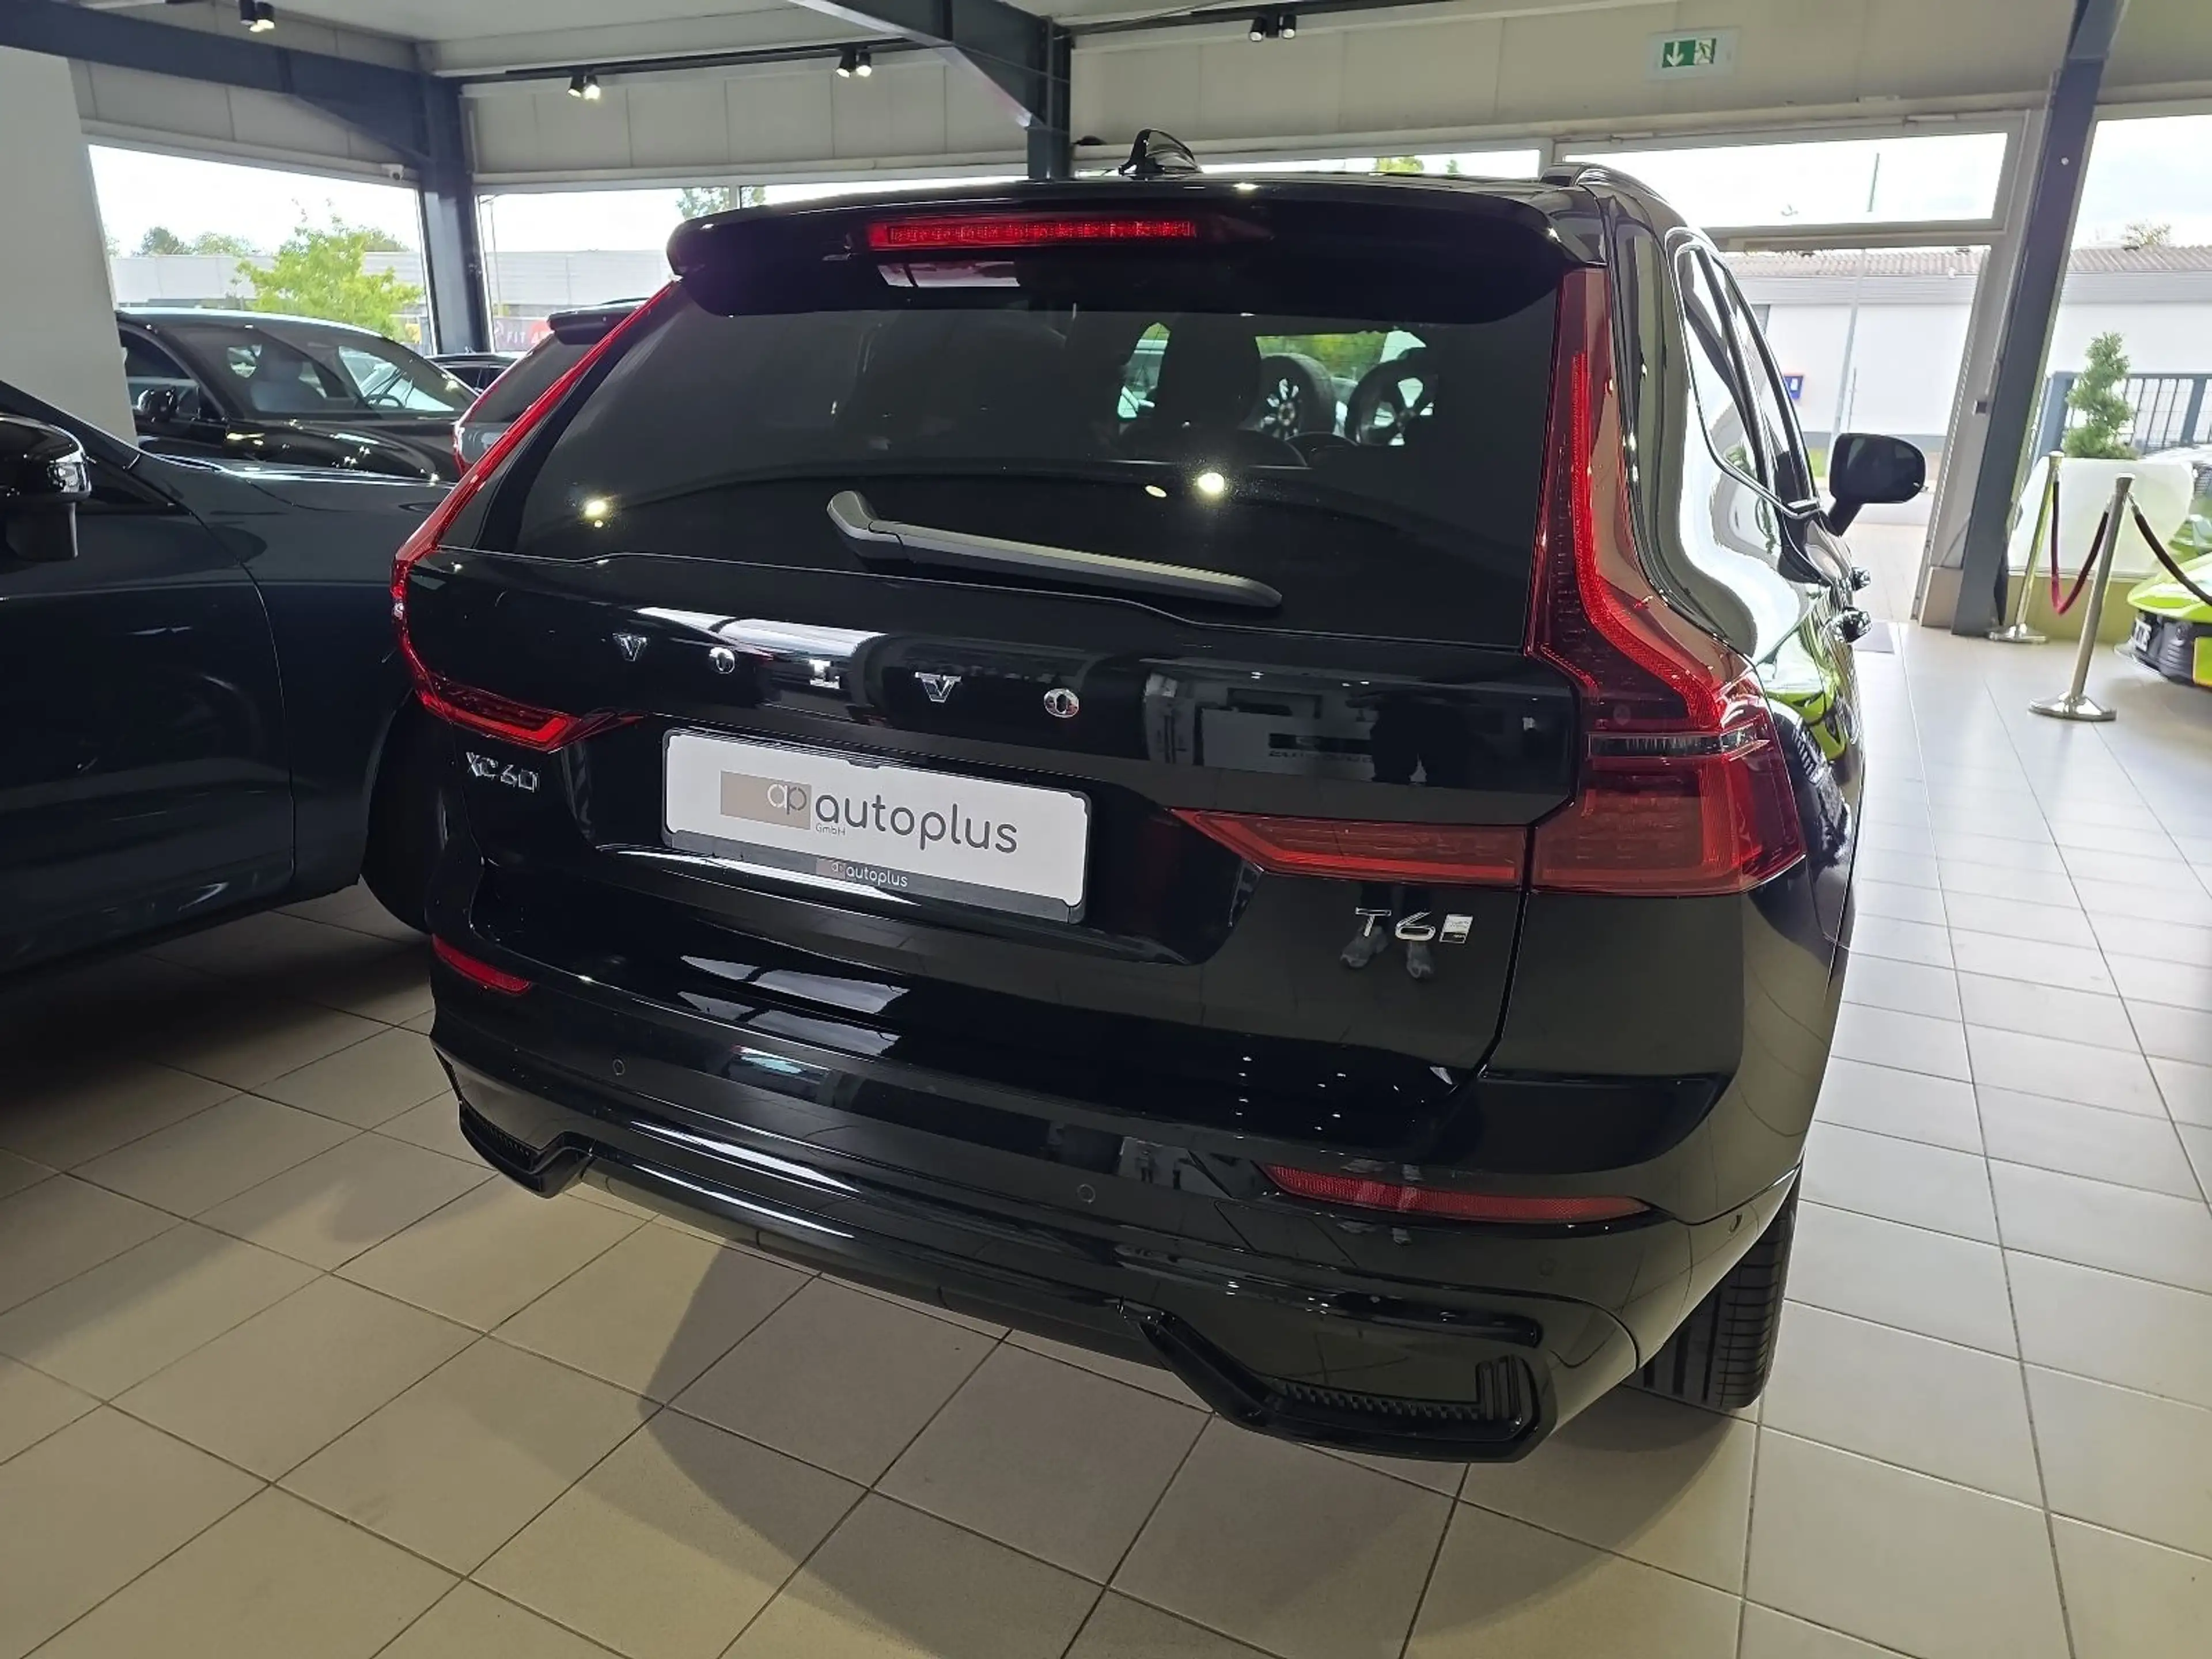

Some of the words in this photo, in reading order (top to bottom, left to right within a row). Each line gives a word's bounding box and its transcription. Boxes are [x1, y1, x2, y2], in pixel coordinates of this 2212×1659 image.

[612, 632, 1080, 718] VOLVO
[465, 752, 540, 793] XC60
[815, 794, 1017, 854] autoplus
[815, 823, 846, 836] GmbH
[846, 866, 908, 888] autoplus
[1355, 907, 1436, 941] T6
